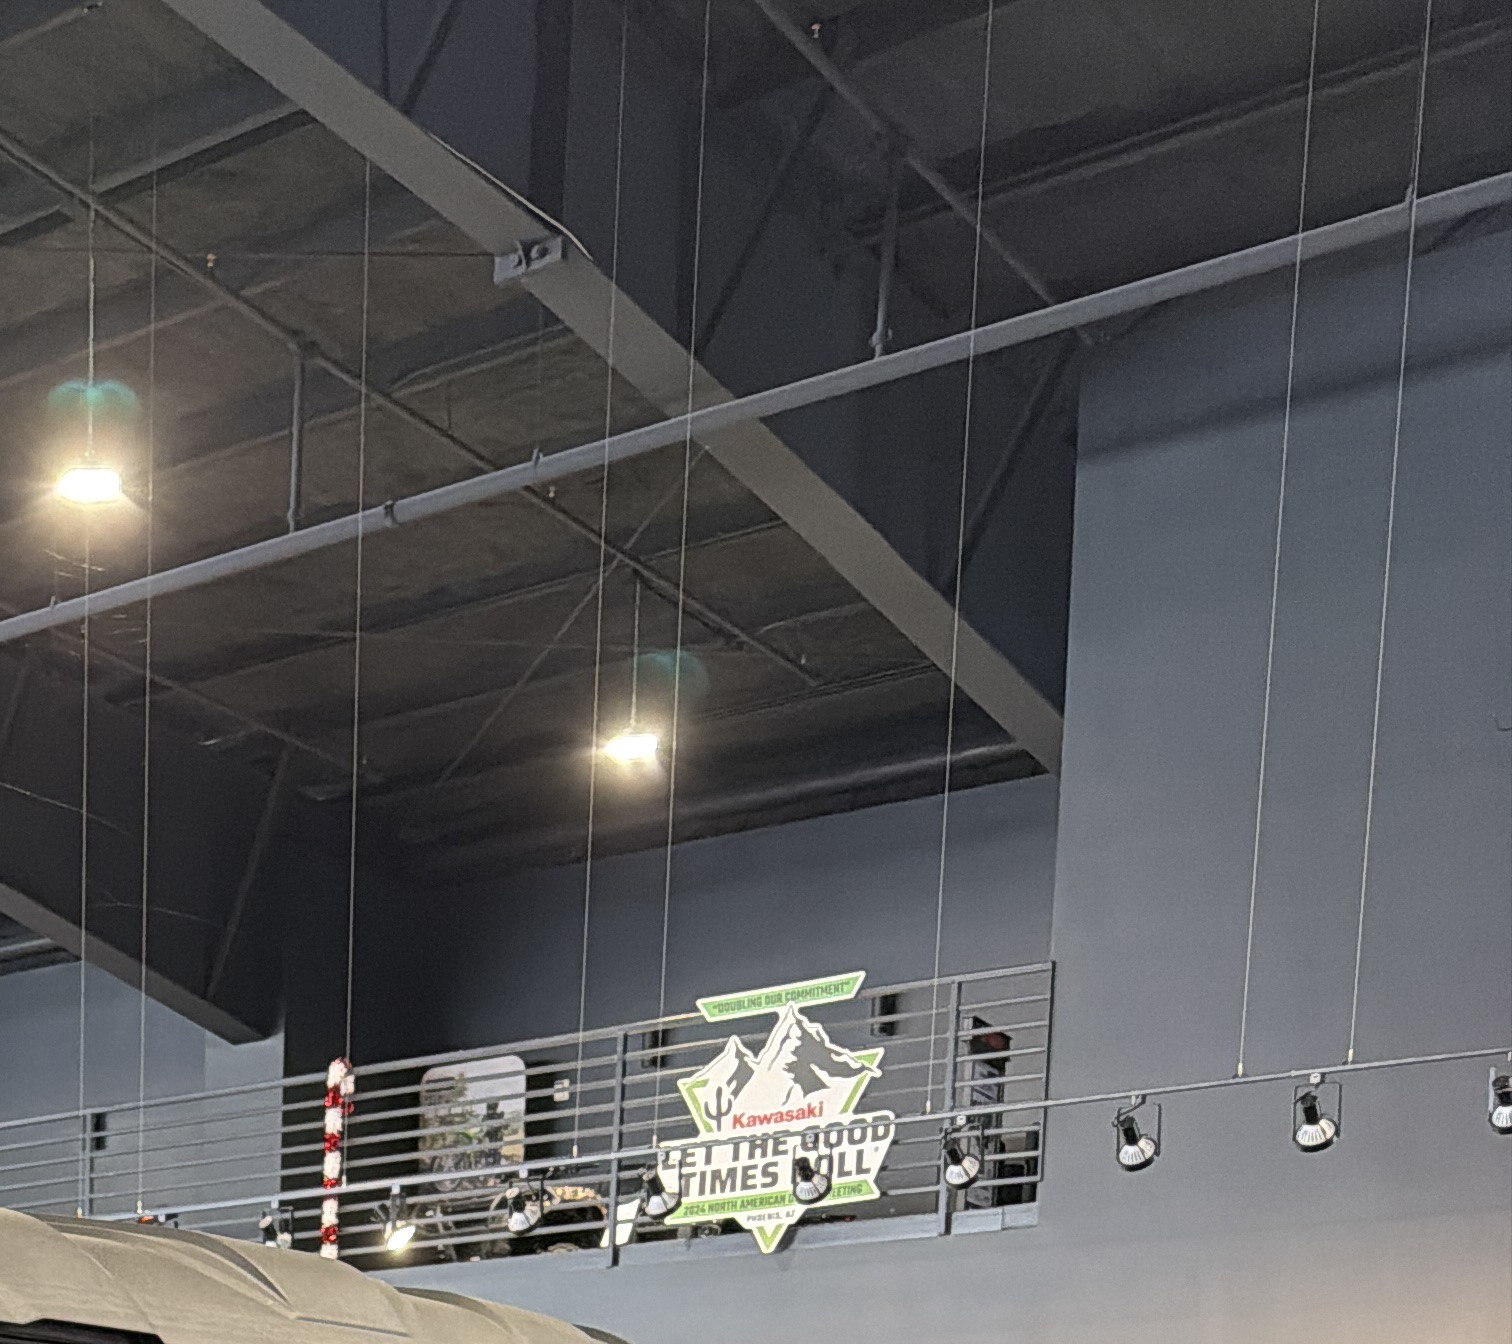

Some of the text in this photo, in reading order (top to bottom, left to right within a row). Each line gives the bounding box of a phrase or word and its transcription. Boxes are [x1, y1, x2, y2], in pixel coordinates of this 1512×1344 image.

[731, 1101, 824, 1130] Kawasaki
[678, 1161, 780, 1199] TIMES
[707, 1199, 738, 1214] NORTH
[739, 1192, 787, 1210] AMERICAN
